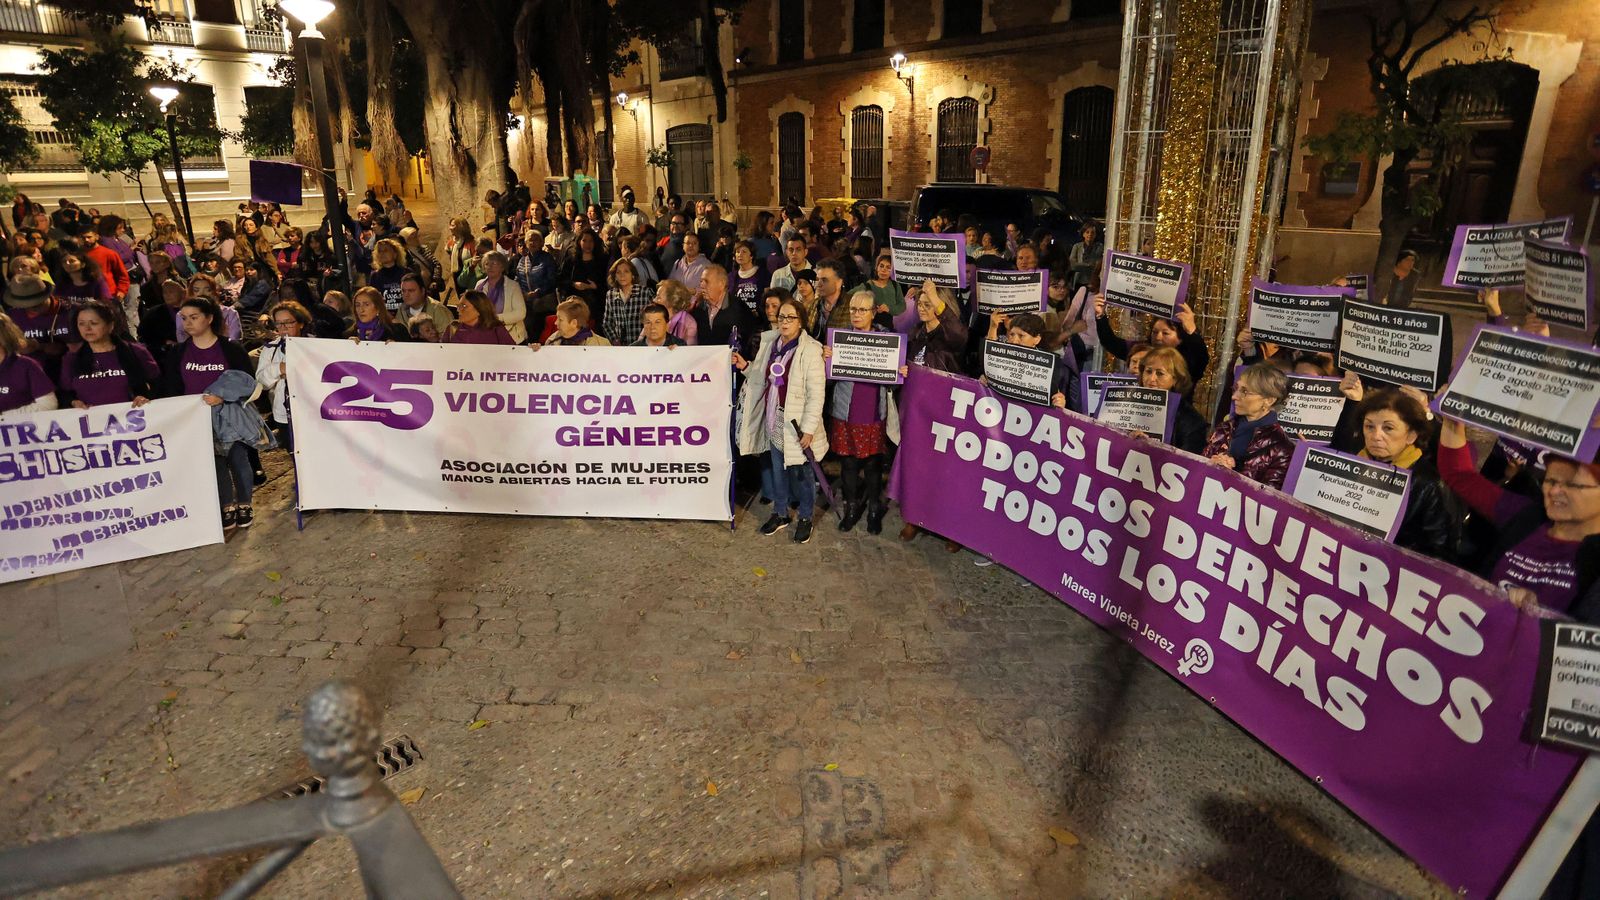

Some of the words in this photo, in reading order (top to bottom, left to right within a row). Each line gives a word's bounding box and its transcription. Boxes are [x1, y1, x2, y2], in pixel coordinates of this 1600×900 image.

[1468, 230, 1514, 241] CLAUDIA
[1114, 258, 1136, 268] IVETT
[1156, 267, 1174, 276] años
[1457, 274, 1480, 282] STOP
[1120, 296, 1145, 307] VIOLENCIA
[1145, 302, 1171, 314] MACHISTA
[1259, 294, 1280, 304] MAITE
[1310, 299, 1330, 307] años
[1348, 308, 1380, 322] CRISTINA
[1393, 317, 1403, 325] 18
[1404, 318, 1428, 329] años
[24, 327, 69, 338] #Hras
[1268, 334, 1301, 345] VIOLENCIA
[1351, 322, 1390, 337] Apuñalada
[1391, 332, 1406, 341] por
[1408, 334, 1420, 342] su
[1343, 330, 1371, 342] expareja
[1378, 336, 1389, 346] de
[1389, 339, 1408, 349] julio
[1409, 342, 1433, 353] 2022
[1356, 341, 1376, 351] Parla
[1378, 345, 1410, 358] Madrid
[991, 346, 1006, 354] MARI
[1006, 350, 1027, 358] NIEVES
[1479, 340, 1513, 354] NOMBRE
[1513, 348, 1577, 368] DESCONOCIDO
[78, 369, 126, 379] #artas
[185, 361, 225, 372] #Hartas
[1340, 355, 1355, 365] STOP
[1354, 361, 1390, 376] VIOLENCIA
[1390, 369, 1433, 384] MACHISTA
[1468, 352, 1517, 373] Apuñalada
[1518, 367, 1536, 378] por
[1537, 371, 1550, 381] su
[1550, 375, 1595, 392] expareja
[446, 368, 474, 381] DÍA
[479, 371, 612, 384] INTERNACIONAL
[616, 372, 686, 384] CONTRA
[690, 372, 711, 383] LA
[1033, 372, 1048, 380] junio
[1479, 368, 1490, 377] 12
[1491, 370, 1506, 381] de
[1507, 377, 1542, 391] agosto
[1542, 384, 1570, 398] 2022
[320, 360, 435, 431] 25
[1021, 391, 1048, 401] MACHISTA
[1292, 382, 1305, 391] 46
[1306, 383, 1332, 393] años
[1501, 385, 1534, 400] Sevilla
[444, 391, 637, 416] VIOLENCIA
[649, 402, 680, 415] DE
[1142, 393, 1162, 402] años
[1297, 395, 1328, 404] disparos
[328, 407, 388, 419] Noviembre
[1278, 413, 1302, 423] Ceuta
[78, 409, 148, 439] LAS
[1128, 422, 1150, 431] Toledo
[1443, 398, 1470, 412] STOP
[1469, 407, 1521, 430] VIOLENCIA
[1520, 421, 1575, 446] MACHISTA
[555, 420, 711, 448] GÉNERO
[440, 458, 568, 474] ASOCIACIÓN
[575, 461, 603, 474] DE
[610, 460, 711, 474] MUJERES
[1307, 453, 1351, 473] VICTORIA
[1352, 466, 1361, 475] C.
[1362, 470, 1378, 480] A.S.
[1379, 474, 1389, 482] 47
[441, 473, 494, 485] MANOS
[498, 475, 571, 486] ABIERTAS
[575, 475, 622, 486] HACIA
[627, 476, 644, 485] EL
[649, 475, 710, 486] FUTURO
[1318, 473, 1360, 491] Apuñalada
[1366, 487, 1375, 496] de
[1375, 490, 1390, 500] abril
[3, 470, 164, 520] DENUNCIA
[1317, 490, 1351, 507] Nohales
[1352, 502, 1380, 517] Cuenca
[1344, 490, 1363, 501] 2022
[52, 505, 189, 552] LIBERTAD
[950, 387, 1087, 460] TODAS
[1095, 437, 1189, 503] LAS
[1197, 476, 1488, 657] MUJERES
[930, 421, 1065, 495] TODOS
[1071, 473, 1155, 538] LOS
[1162, 514, 1493, 744] DERECHOS
[981, 477, 1113, 566] TODOS
[1118, 545, 1210, 623] LOS
[1219, 601, 1368, 732] DÍAS
[1061, 572, 1097, 604] Marea
[1099, 594, 1139, 631] Violeta
[1140, 623, 1177, 655] Jerez
[1548, 716, 1586, 733] STOP
